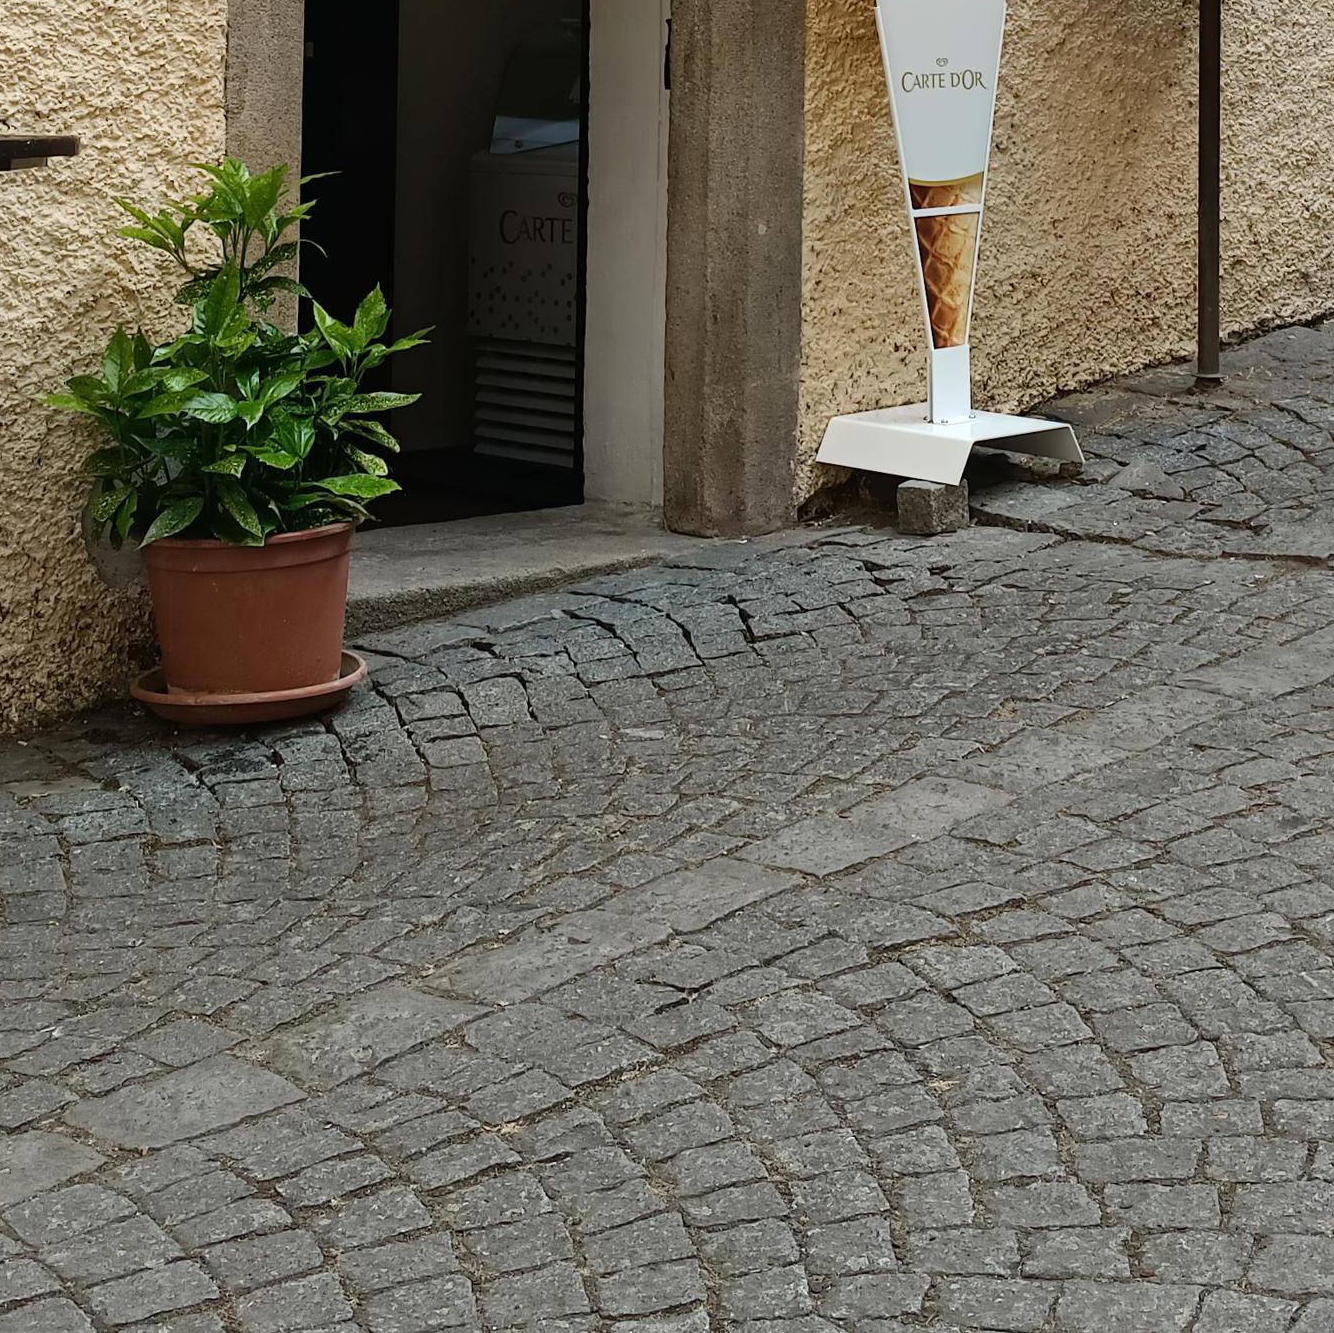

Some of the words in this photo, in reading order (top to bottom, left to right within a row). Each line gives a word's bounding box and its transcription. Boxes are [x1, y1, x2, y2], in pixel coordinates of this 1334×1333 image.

[901, 70, 946, 93] CARTE
[950, 69, 987, 90] D'OR
[499, 210, 574, 245] CARTE
